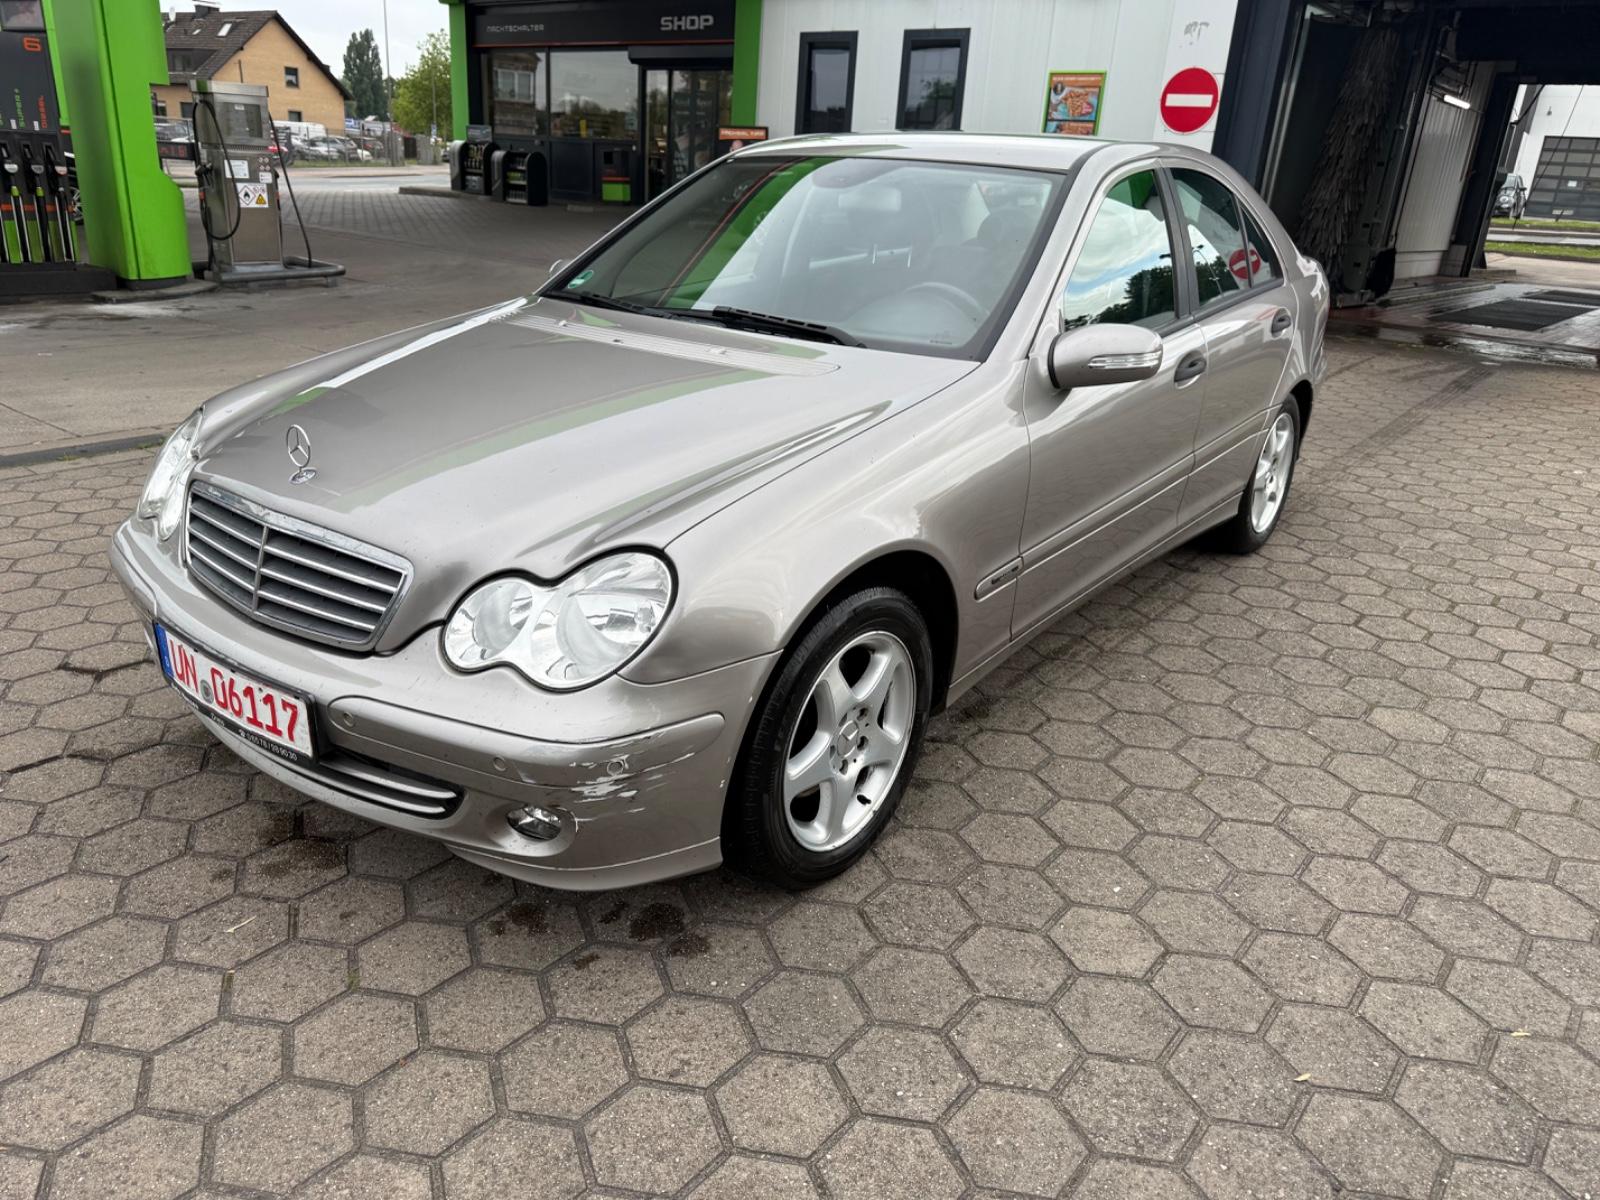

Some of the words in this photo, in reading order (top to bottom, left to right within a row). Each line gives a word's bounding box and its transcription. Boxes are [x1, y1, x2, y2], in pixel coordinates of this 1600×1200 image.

[660, 15, 714, 31] SHOP
[23, 37, 42, 51] 6
[170, 639, 199, 693] UN
[210, 666, 298, 743] 06117
